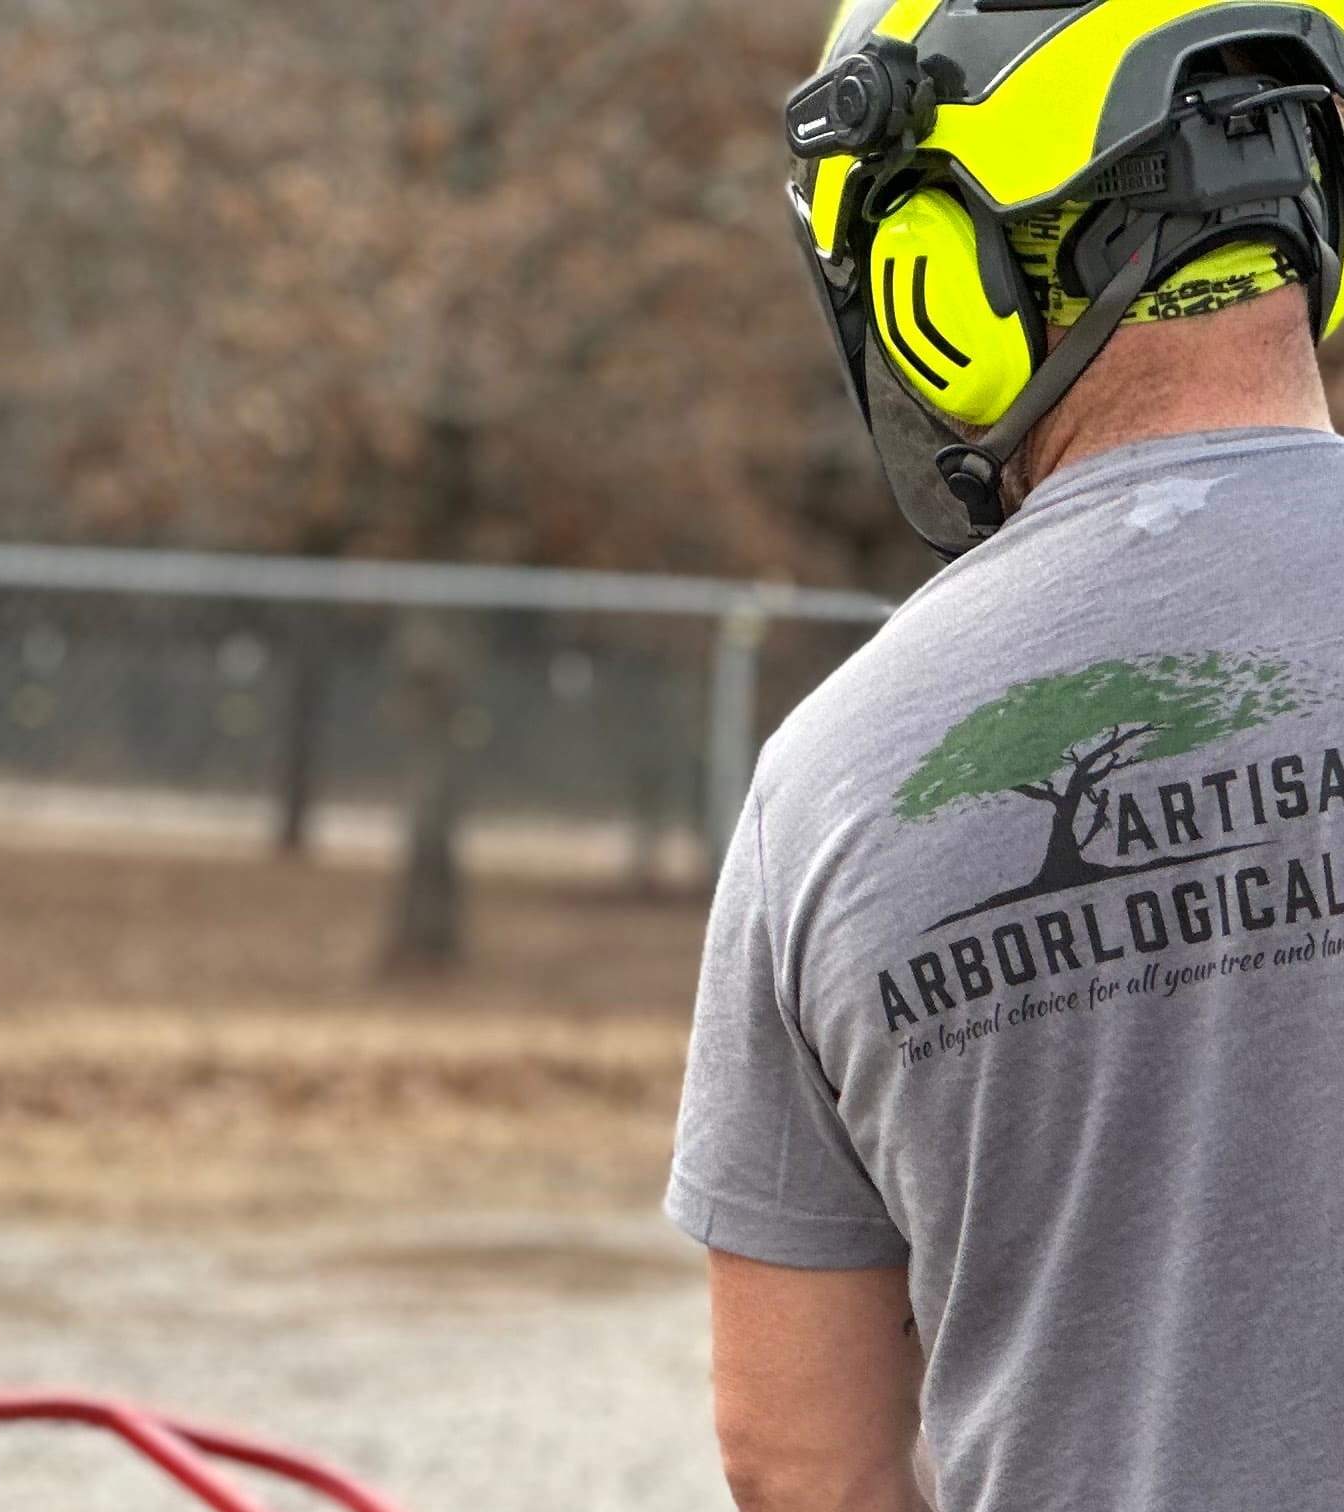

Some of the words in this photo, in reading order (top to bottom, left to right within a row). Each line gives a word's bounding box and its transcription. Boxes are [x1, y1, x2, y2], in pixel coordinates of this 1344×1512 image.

[900, 1036, 933, 1069] The
[939, 1003, 1001, 1056] logical
[1008, 994, 1079, 1026] choice
[1088, 977, 1120, 1009] for
[1128, 964, 1159, 992] all
[1163, 962, 1217, 997] your
[1221, 951, 1265, 975] tree
[1274, 933, 1315, 965] and
